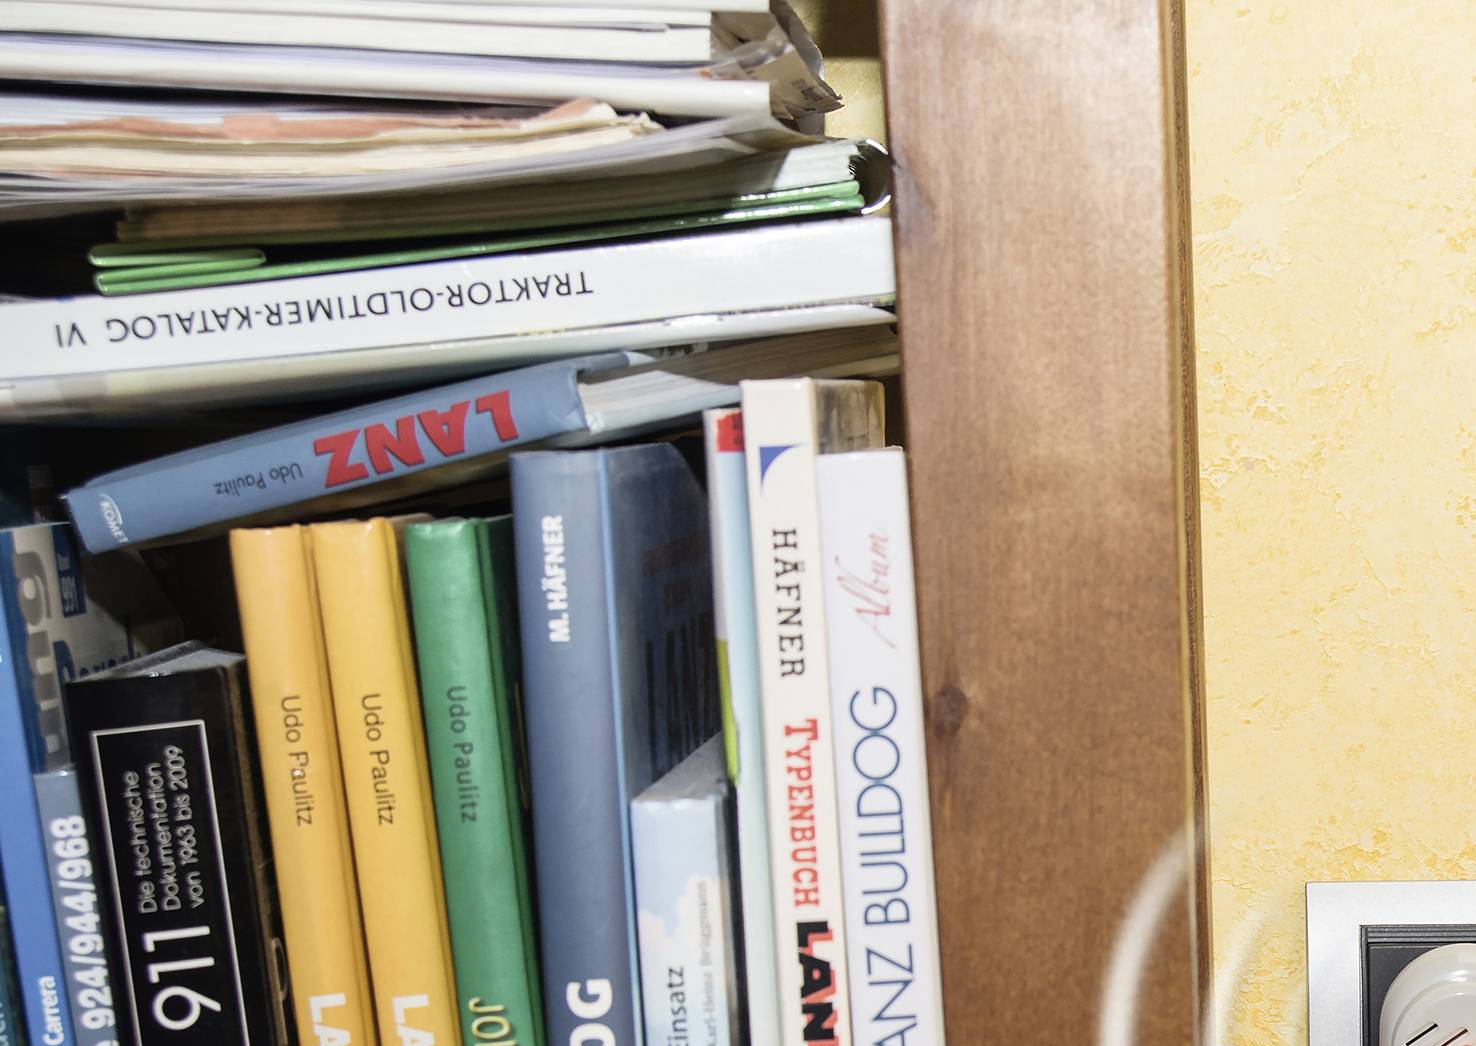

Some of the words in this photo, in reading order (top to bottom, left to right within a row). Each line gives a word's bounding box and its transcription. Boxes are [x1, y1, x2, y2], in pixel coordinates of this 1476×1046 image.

[56, 322, 87, 348] VI
[106, 271, 594, 343] TRAKTOR-OLDTIMER-KATALOG
[269, 461, 304, 482] Udo
[314, 390, 519, 488] LANZ
[214, 471, 265, 496] Paulitz
[101, 499, 130, 544] KOMET
[540, 515, 568, 610] HÄFNER
[548, 612, 571, 642] M.
[772, 528, 806, 678] HÄFNER
[280, 695, 302, 743] Udo
[361, 693, 382, 742] Udo
[447, 685, 471, 735] Udo
[163, 744, 189, 791] 2009
[289, 750, 314, 827] Paulitz
[370, 749, 395, 826] Paulitz
[454, 742, 480, 824] Paulitz
[122, 770, 152, 876] technische
[146, 762, 182, 911] Dokumentation
[173, 792, 193, 822] bis
[784, 718, 820, 908] TYPENBUCH
[850, 686, 911, 927] BULLDOG
[175, 823, 199, 867] 1963
[49, 814, 116, 1031] 924/944/968
[139, 880, 158, 914] Die
[185, 870, 205, 909] von
[38, 974, 67, 1046] Carrera
[142, 925, 222, 1032] 911
